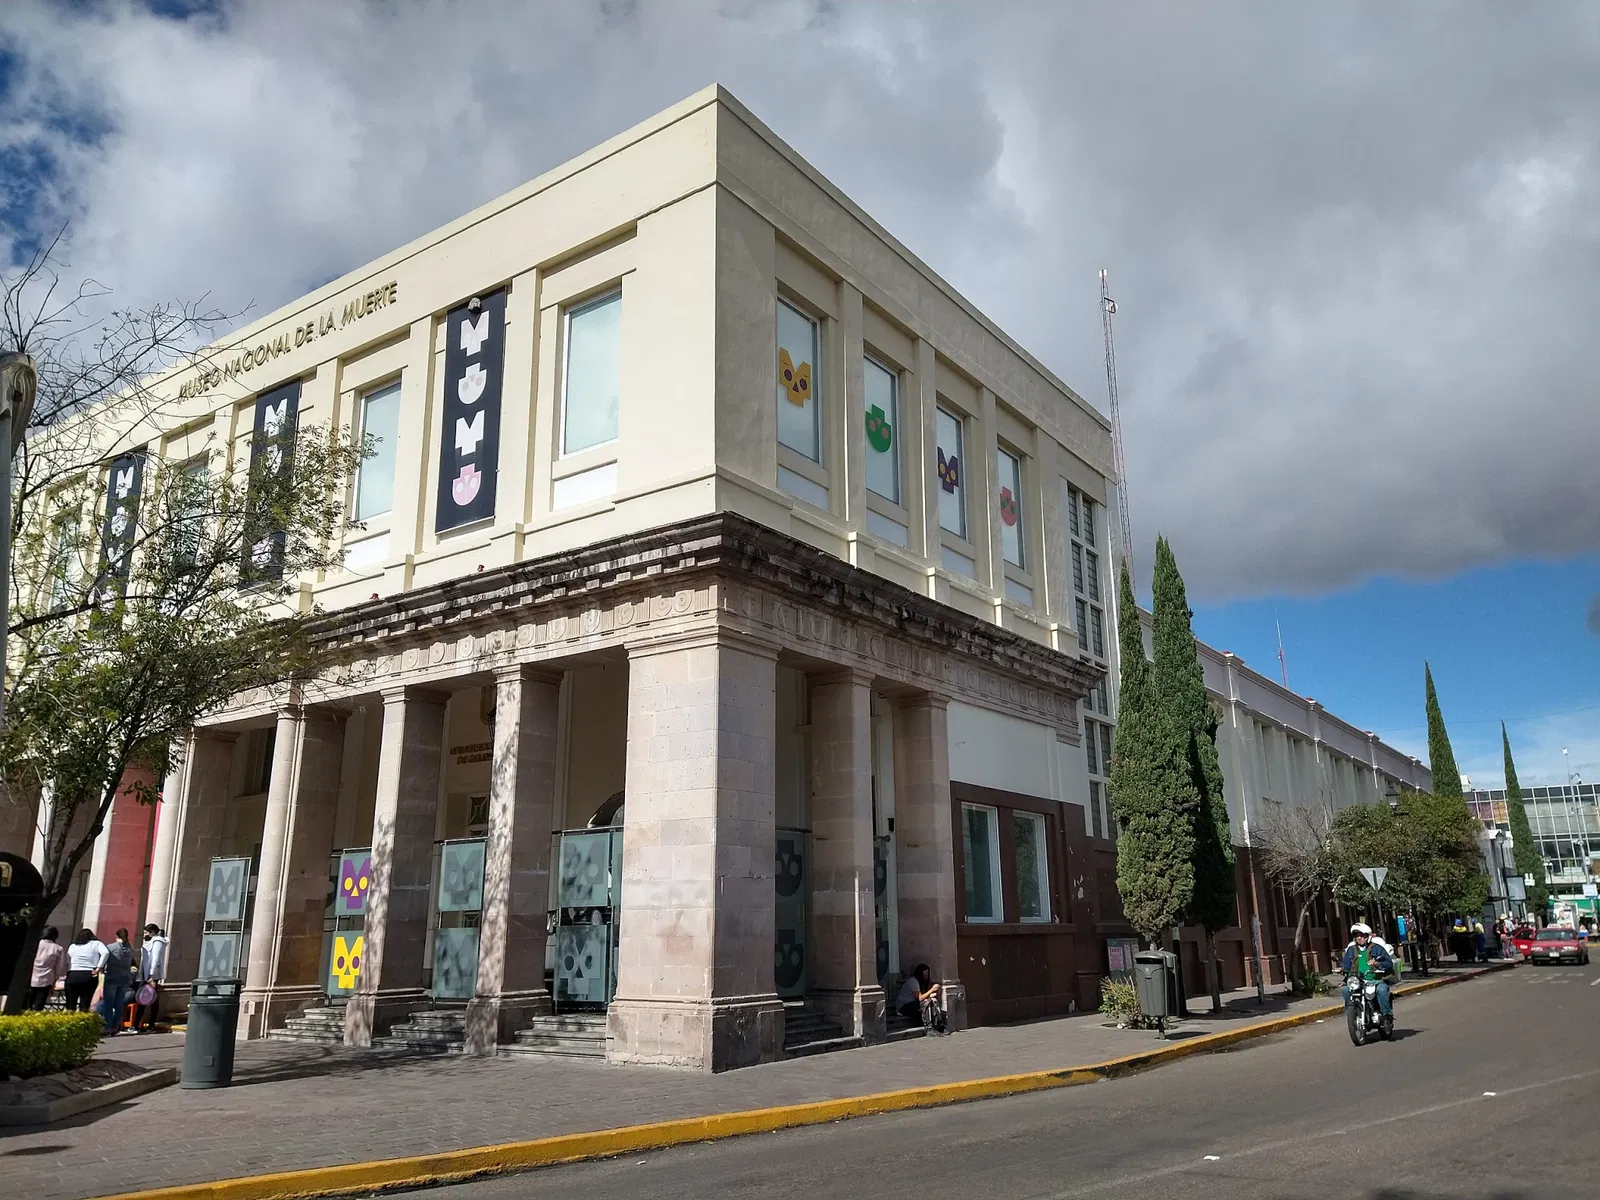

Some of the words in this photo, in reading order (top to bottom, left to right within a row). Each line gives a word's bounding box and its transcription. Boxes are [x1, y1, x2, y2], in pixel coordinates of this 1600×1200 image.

[178, 368, 222, 402] MUSEO
[223, 333, 292, 381] NACIONAL
[294, 321, 315, 348] DE
[319, 311, 337, 337] LA
[341, 280, 398, 327] MUERTE
